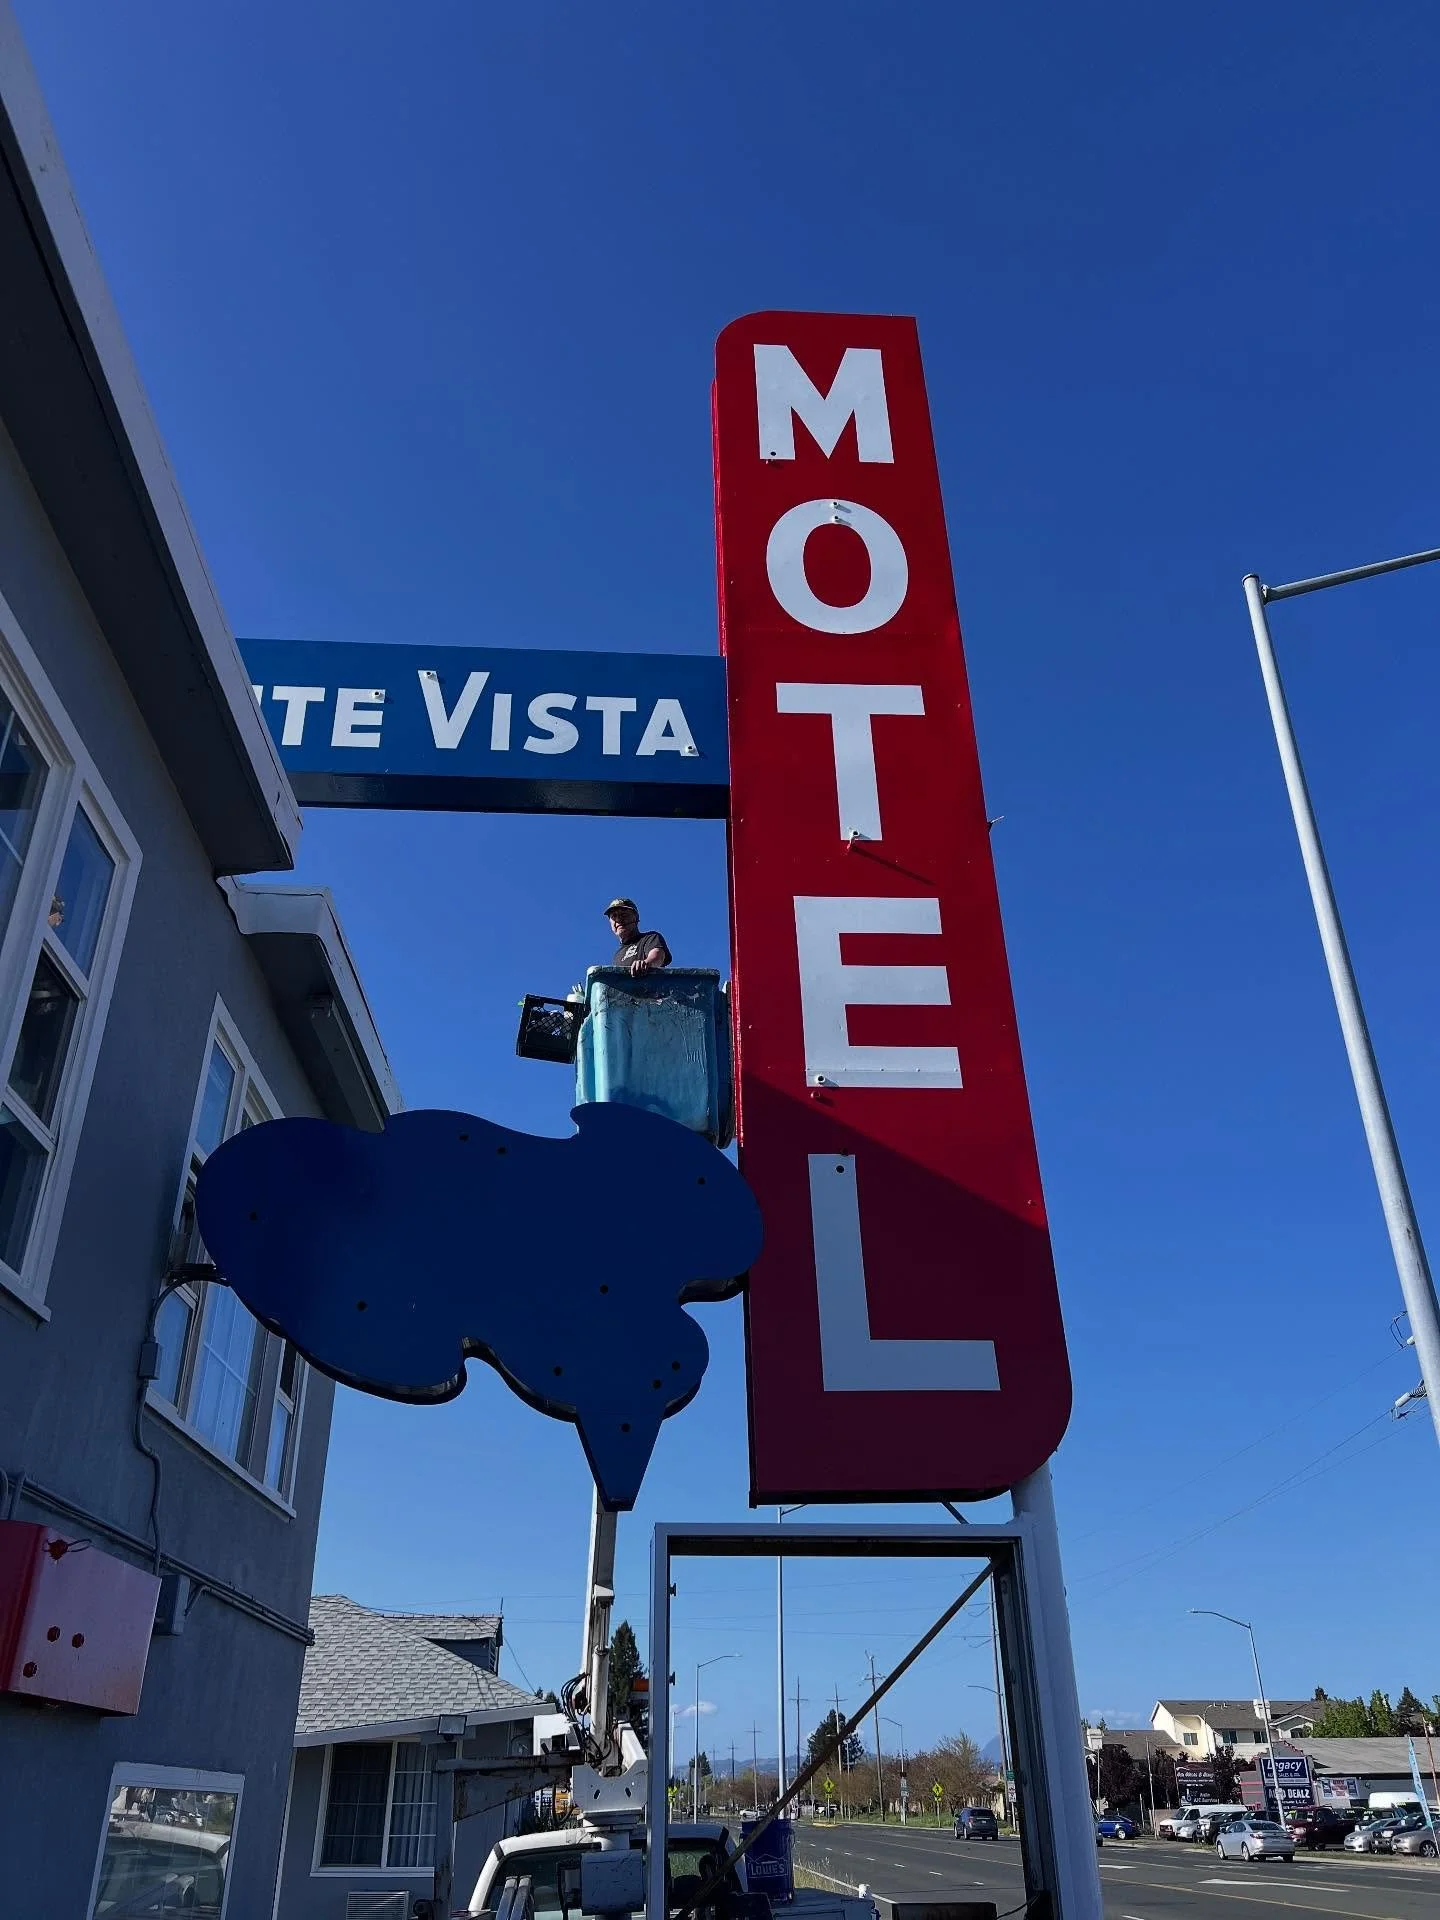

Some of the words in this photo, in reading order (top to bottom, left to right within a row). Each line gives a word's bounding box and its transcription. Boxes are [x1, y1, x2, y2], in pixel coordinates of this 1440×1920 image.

[252, 685, 386, 748] TE
[418, 670, 700, 757] VISTA
[754, 343, 1001, 1392] MOTEL
[1269, 1789, 1286, 1798] AO
[1288, 1789, 1311, 1798] DEALZ
